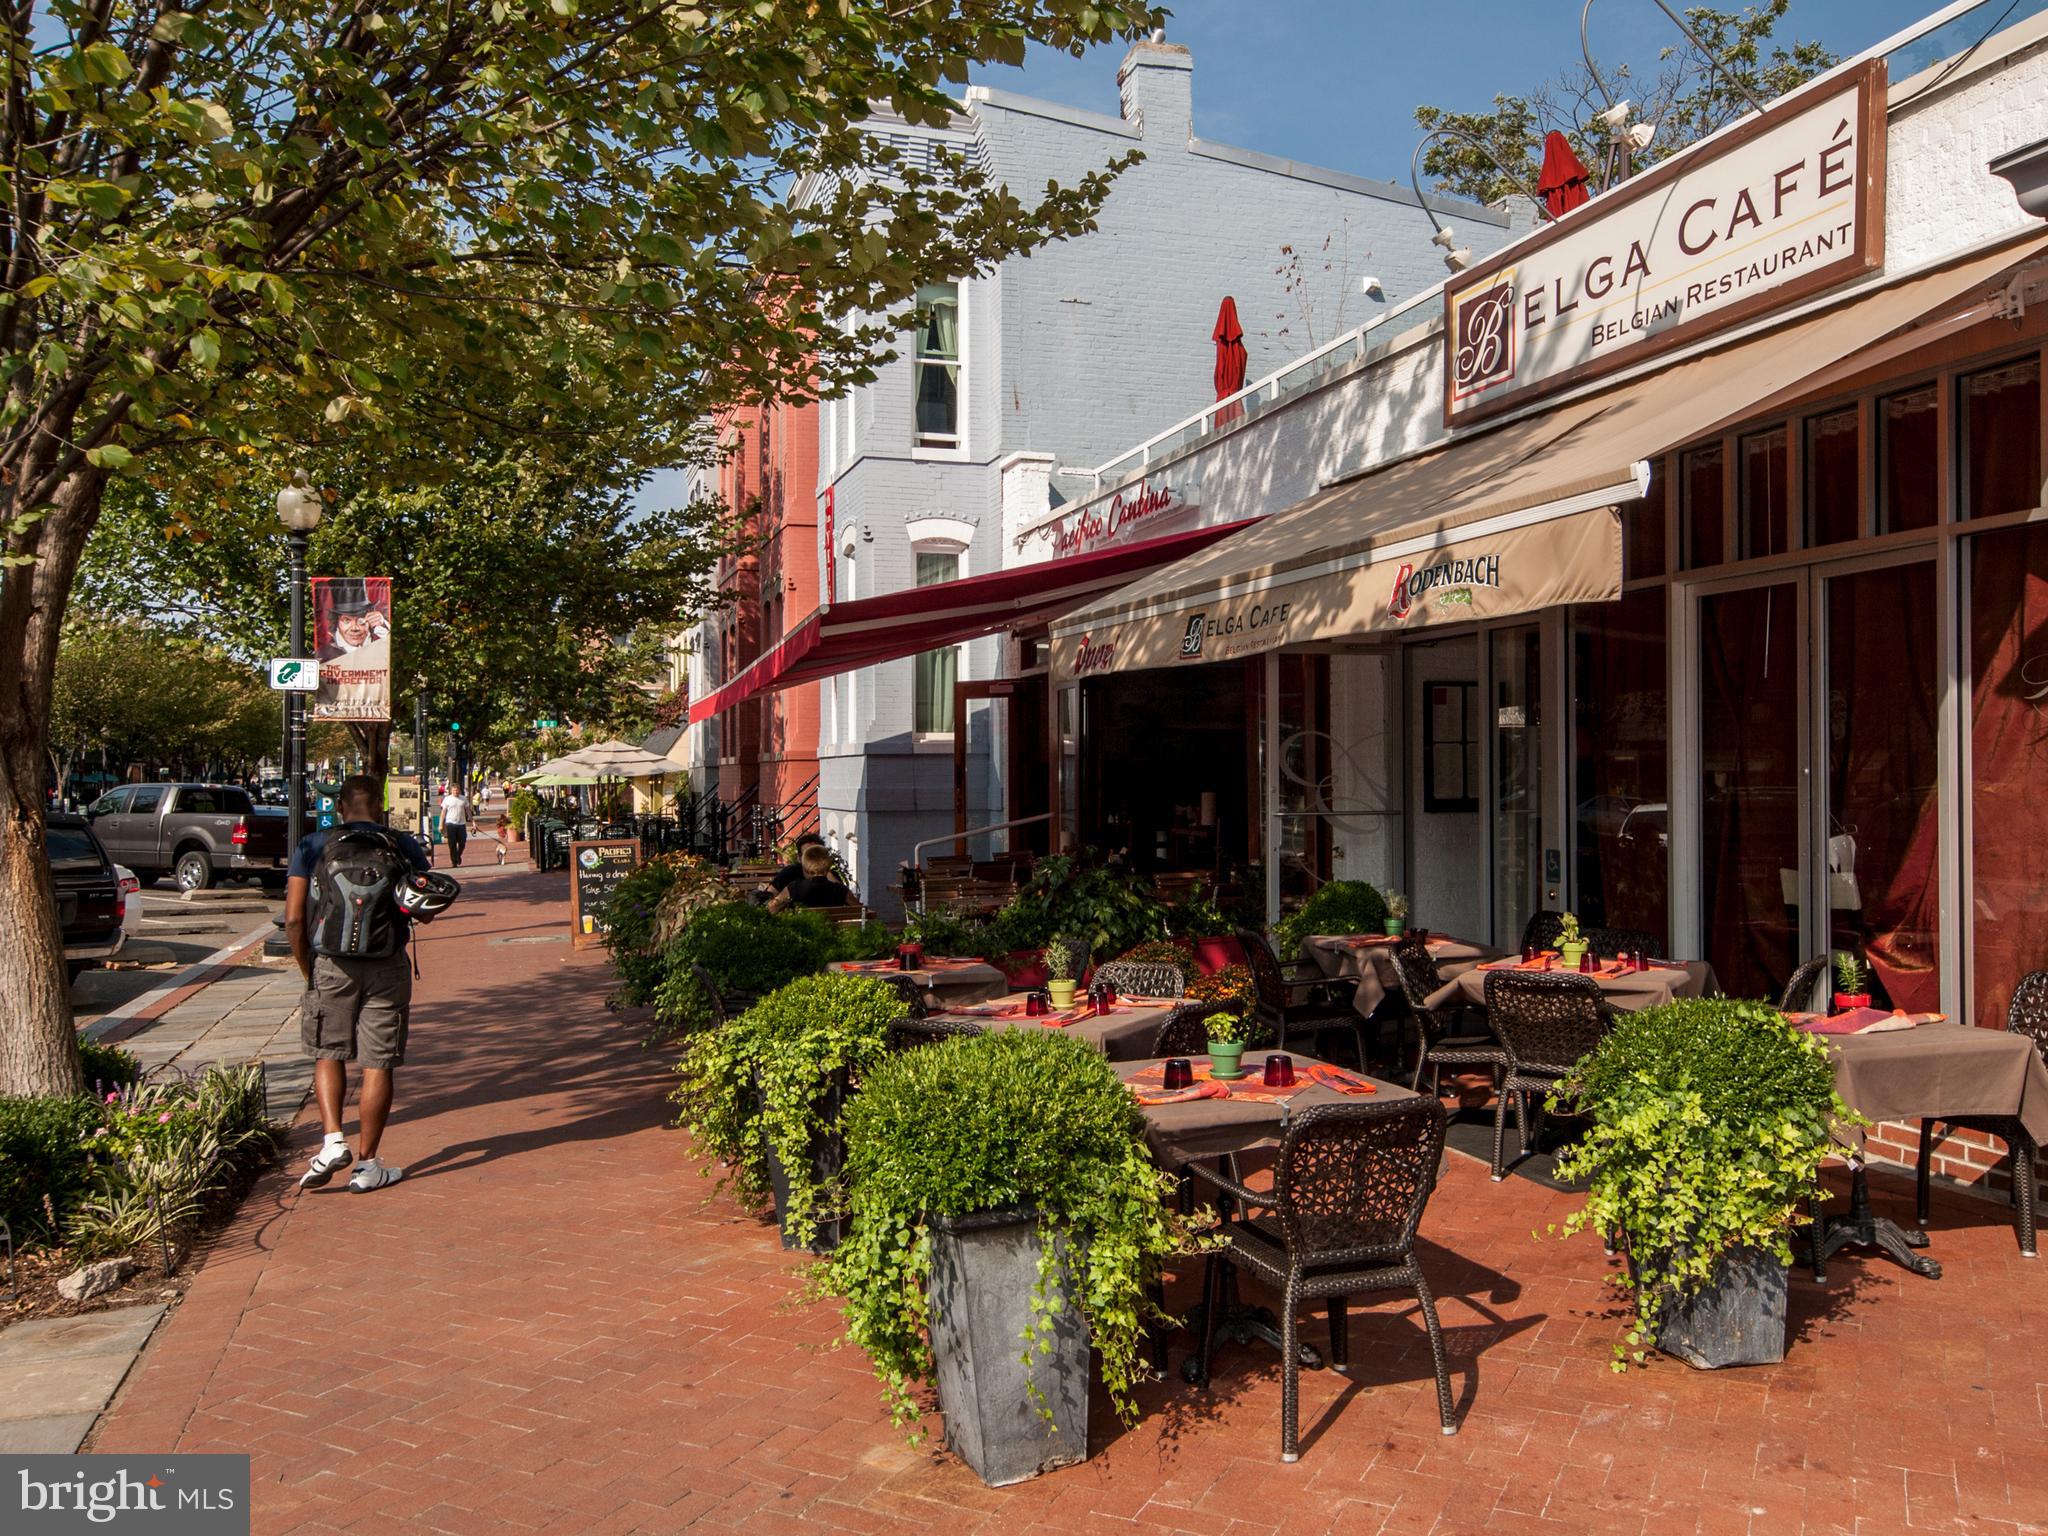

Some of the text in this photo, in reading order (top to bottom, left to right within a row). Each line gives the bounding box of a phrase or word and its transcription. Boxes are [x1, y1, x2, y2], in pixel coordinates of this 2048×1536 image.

[1677, 118, 1854, 256] CAFÉ
[1591, 221, 1853, 348] BELGIAN RESTAURANT
[1052, 478, 1172, 554] Pacifico Cantina
[1387, 553, 1500, 620] RODENBACH
[321, 798, 333, 811] P
